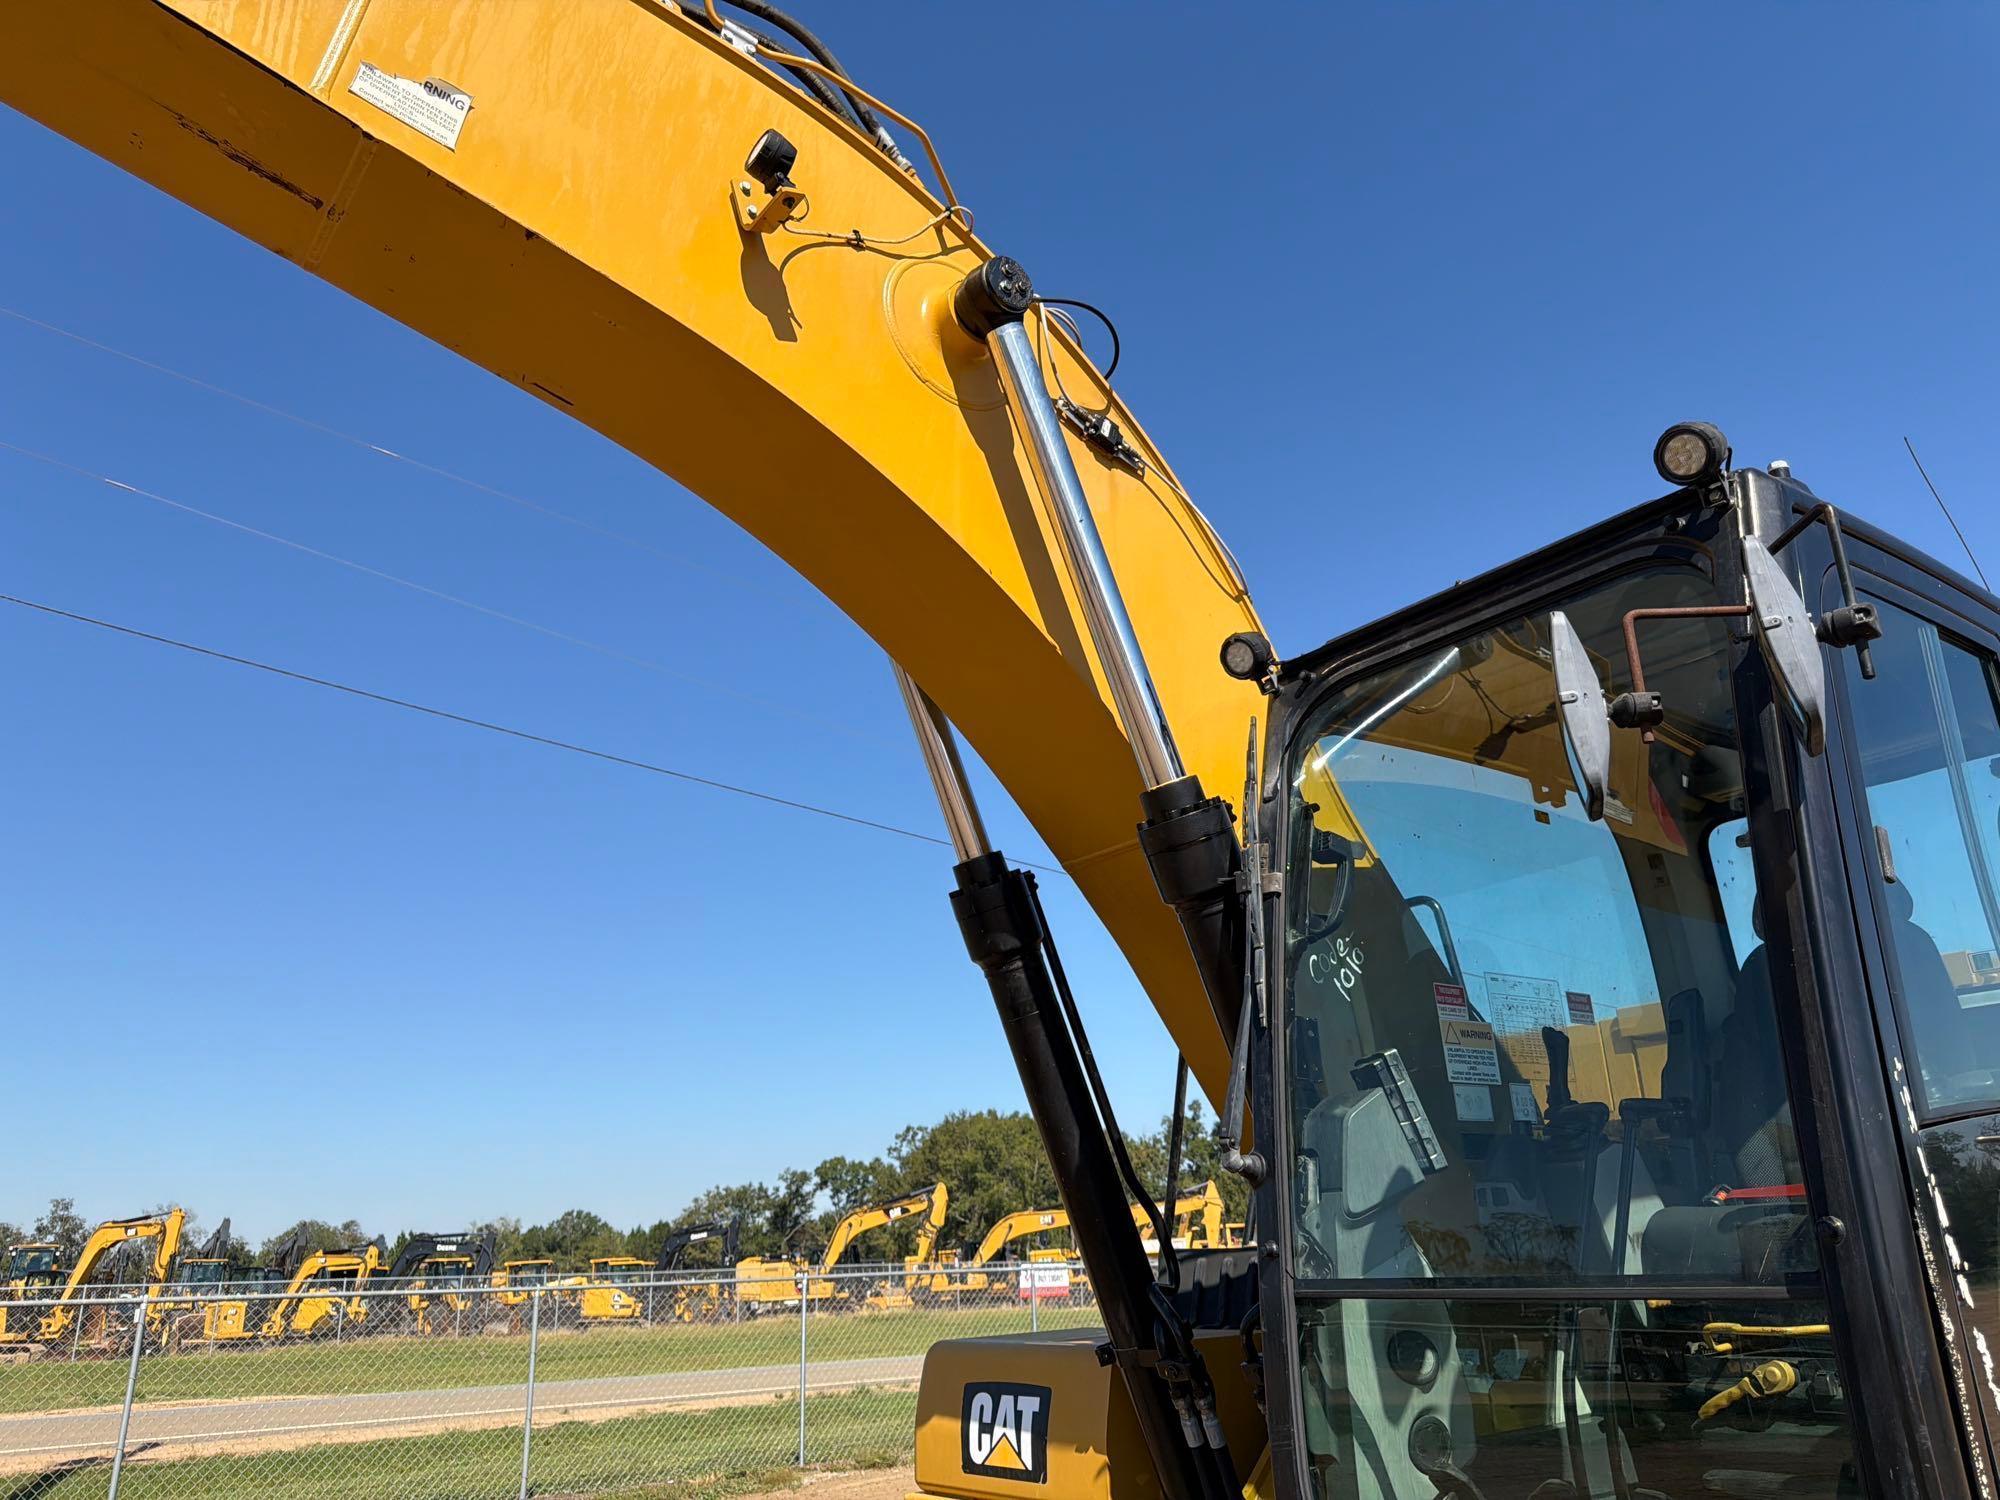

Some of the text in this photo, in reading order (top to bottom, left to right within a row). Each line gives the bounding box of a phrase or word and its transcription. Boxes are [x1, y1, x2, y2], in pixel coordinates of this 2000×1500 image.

[358, 88, 384, 104] Contact
[386, 102, 398, 112] with
[400, 112, 419, 124] power
[362, 70, 401, 96] EQUIPMENT
[402, 95, 425, 111] WITHIN
[426, 108, 438, 118] TEN
[440, 116, 456, 128] FEET
[370, 81, 407, 106] OVERHEAD
[426, 114, 456, 134] VOLTAGE
[402, 88, 411, 96] TO
[412, 95, 444, 116] OPERATE
[444, 113, 458, 124] THIS
[419, 80, 465, 111] RNING
[1460, 1028, 1492, 1041] WARNING
[968, 1392, 1040, 1471] CAT
